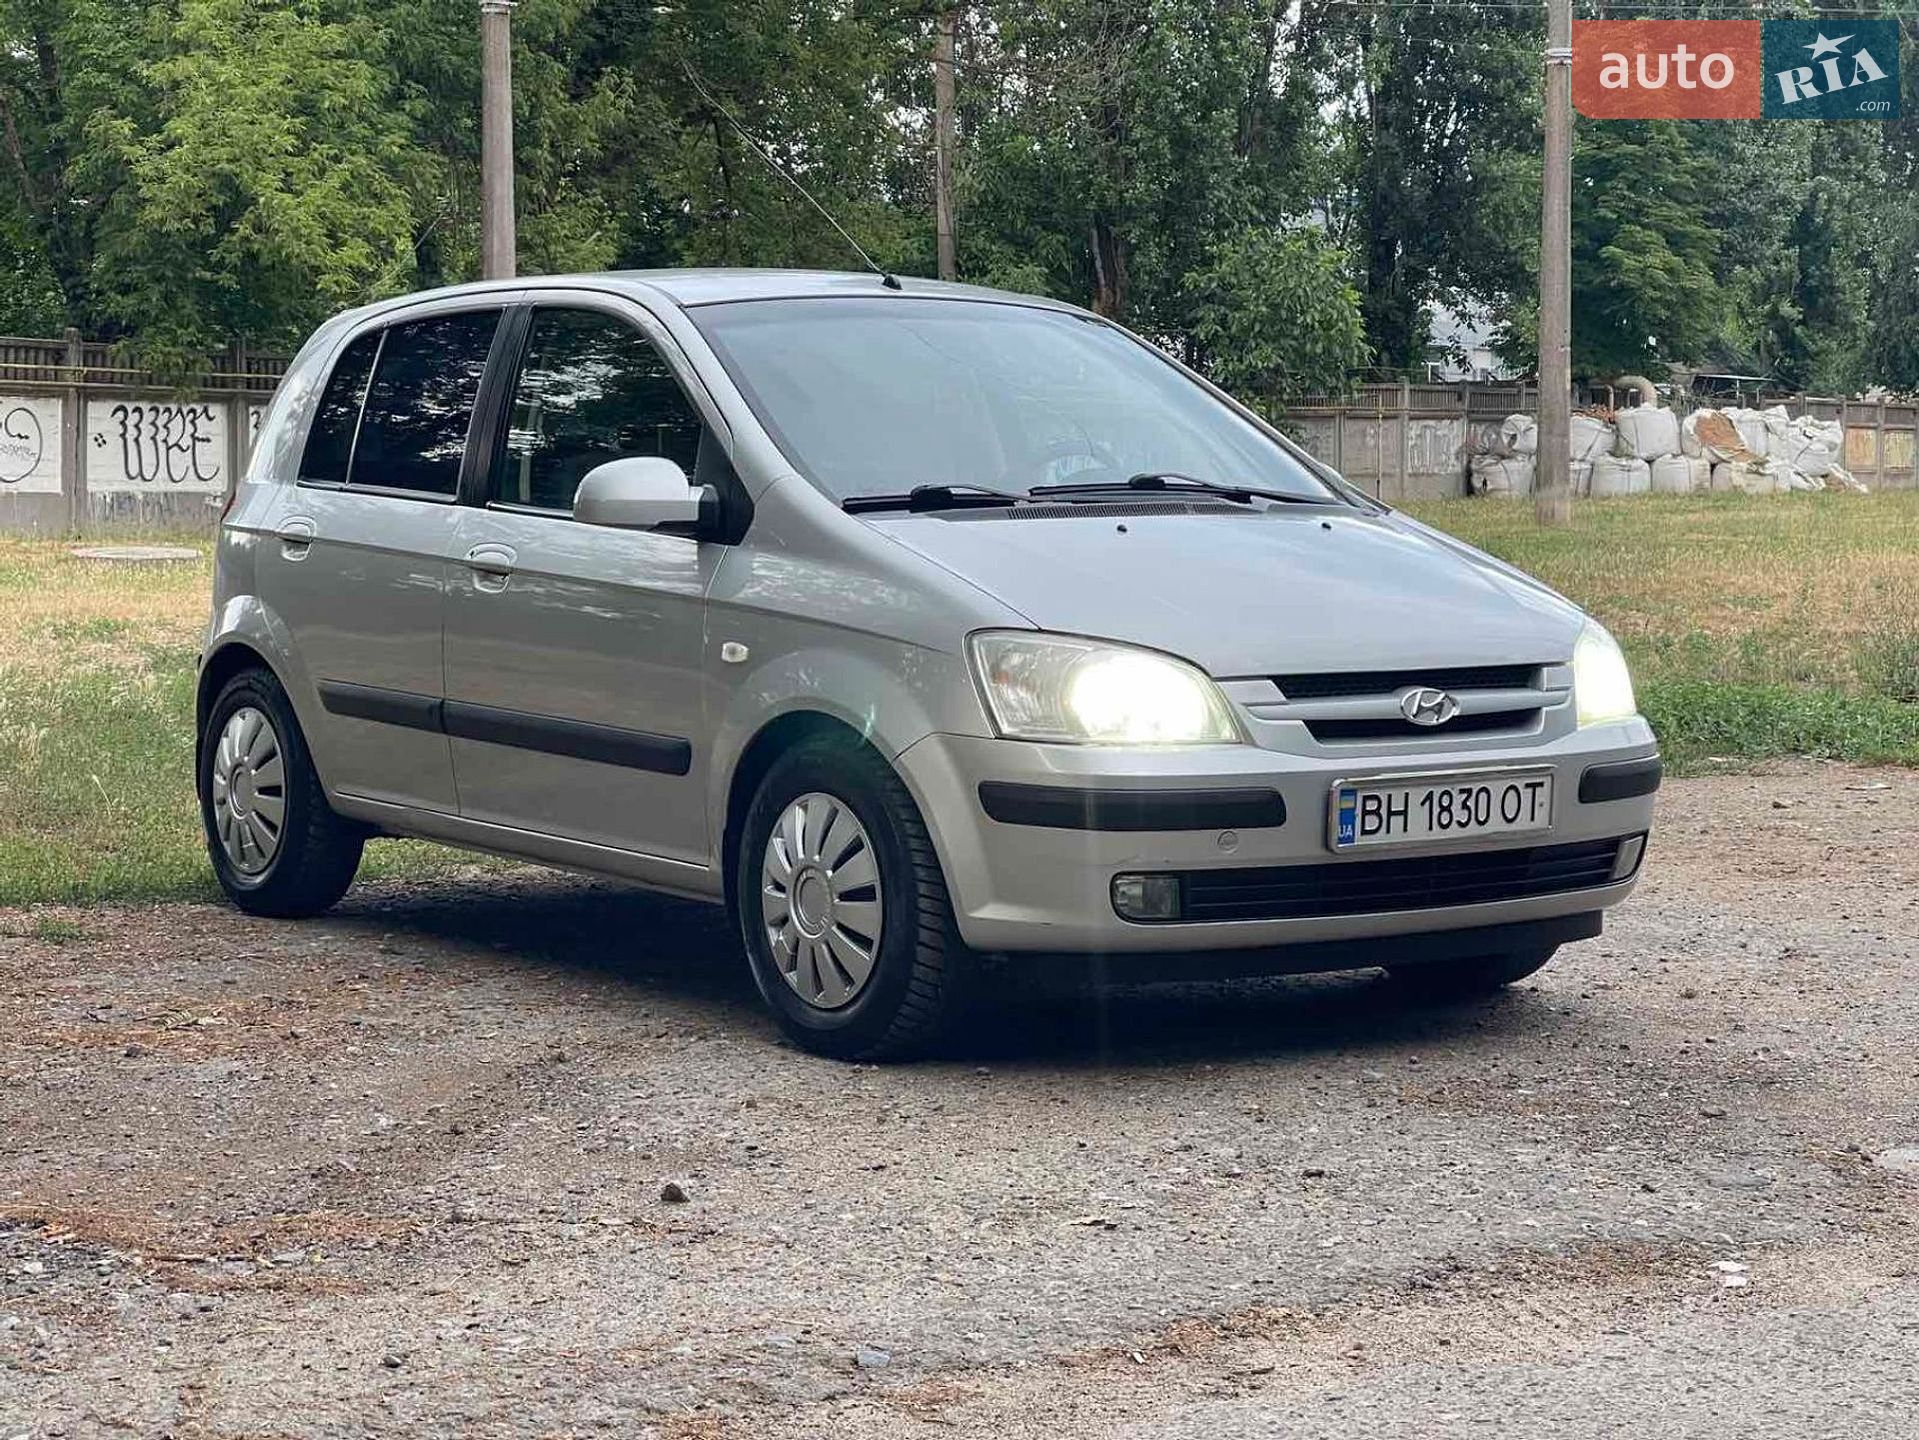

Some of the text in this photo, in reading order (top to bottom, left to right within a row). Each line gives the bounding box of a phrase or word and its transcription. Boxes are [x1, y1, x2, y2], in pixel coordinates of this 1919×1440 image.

[1360, 781, 1545, 836] BH 1830 OT
[1338, 824, 1354, 840] UA
